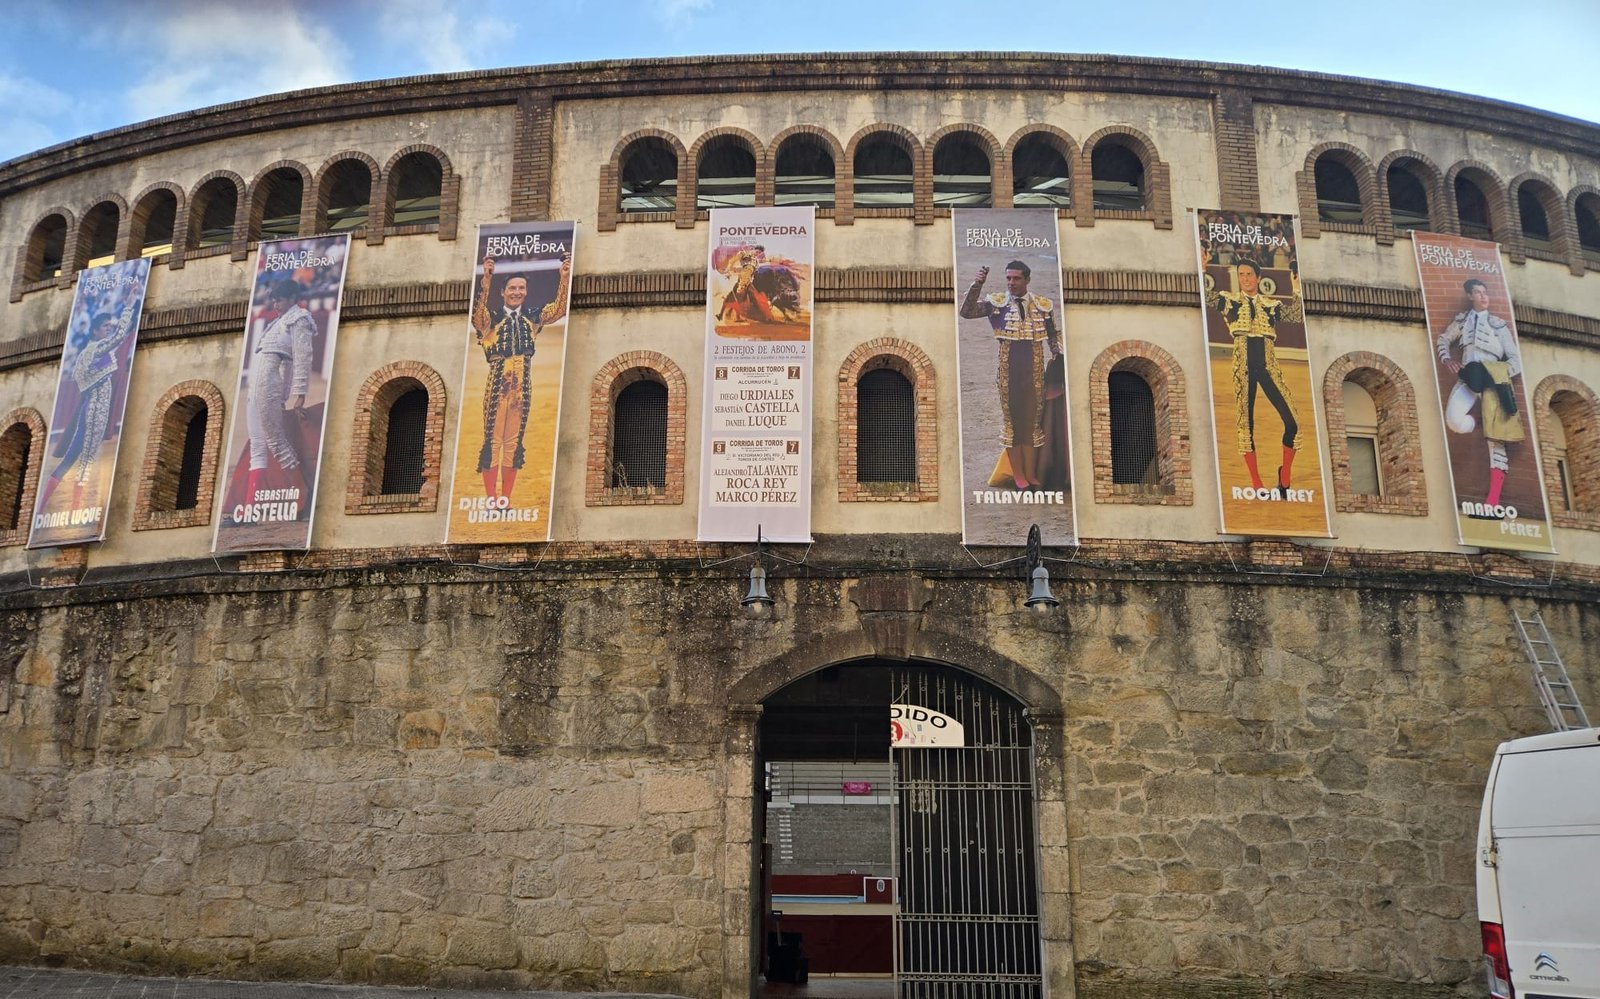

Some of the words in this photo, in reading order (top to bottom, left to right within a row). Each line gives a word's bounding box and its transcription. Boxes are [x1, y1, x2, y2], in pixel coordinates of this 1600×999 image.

[720, 226, 807, 236] PONTEVEDRA
[966, 228, 1000, 238] FERIA
[1006, 228, 1022, 238] DE
[1208, 222, 1242, 234] FERIA
[1246, 226, 1262, 236] DE
[488, 235, 520, 247] FERIA
[525, 234, 540, 244] DE
[966, 238, 1050, 248] PONTEVEDRA
[1210, 232, 1288, 246] PONTEVEDRA
[486, 242, 566, 256] PONTEVEDRA
[1420, 244, 1453, 257] FERIA
[1457, 249, 1473, 260] DE
[266, 252, 295, 263] FERIA
[300, 250, 314, 260] DE
[264, 256, 335, 272] PONTEVEDRA
[1422, 254, 1500, 274] PONTEVEDRA
[83, 276, 139, 296] PONTEVEDRA
[1263, 281, 1272, 292] 9
[714, 346, 719, 354] 2
[722, 346, 754, 356] FESTEJOS
[758, 346, 768, 354] DE
[770, 345, 798, 355] ABONO,
[801, 345, 806, 354] 2
[740, 390, 794, 401] URDIALES
[714, 406, 744, 414] SEBASTIÁN
[745, 402, 800, 413] CASTELLA
[748, 416, 787, 428] LUQUE
[747, 465, 798, 476] TALAVANTE
[726, 478, 760, 488] ROCA
[763, 478, 788, 488] REY
[254, 486, 300, 501] SEBASTIÁN
[716, 492, 758, 502] MARCO
[761, 488, 797, 502] PÉREZ
[972, 490, 1064, 504] TALAVANTE
[1232, 486, 1280, 501] ROCA
[1286, 488, 1314, 503] REY
[459, 496, 510, 510] DIEGO
[34, 511, 70, 529] DANIEL
[70, 506, 103, 525] LUQUE
[233, 502, 298, 523] CASTELLA
[468, 508, 540, 524] URDIALES
[1462, 502, 1518, 519] MARCO
[1500, 520, 1542, 538] PÉREZ
